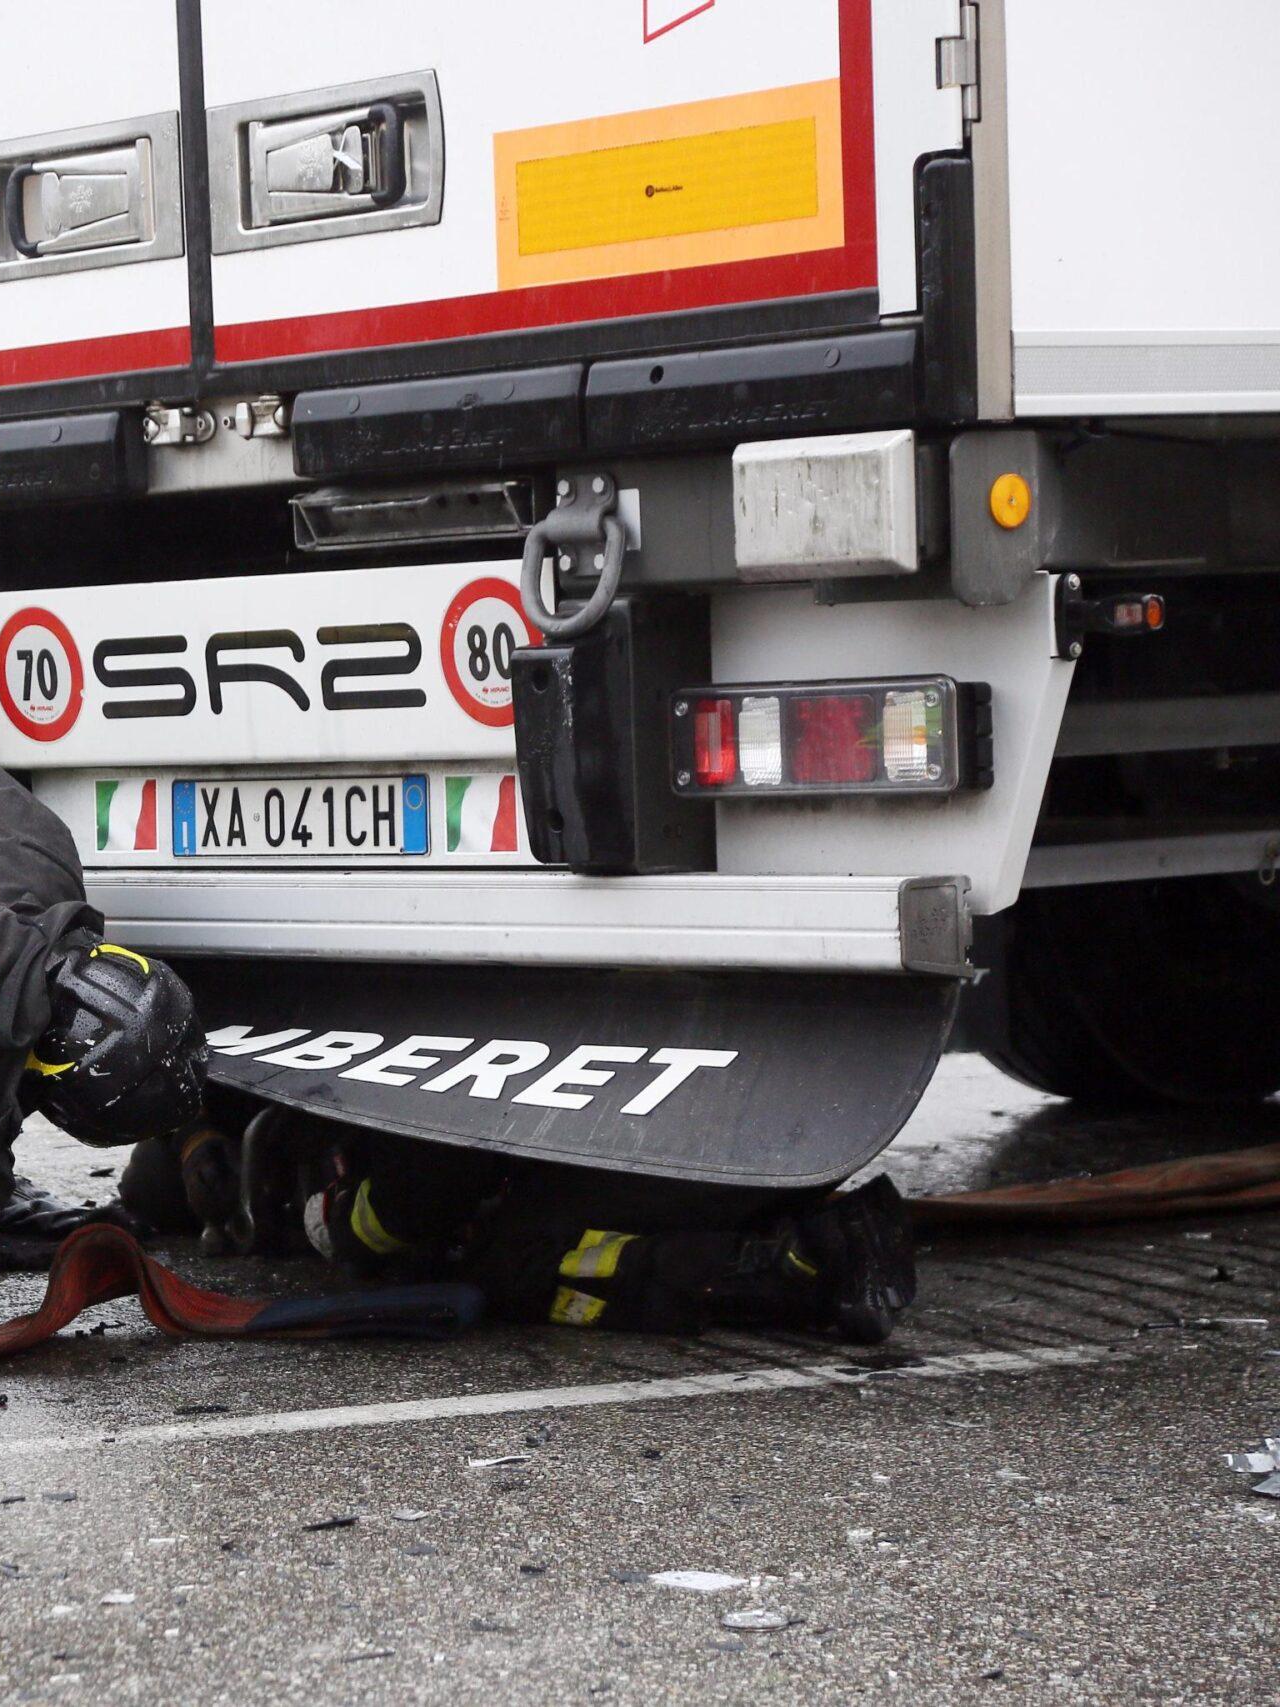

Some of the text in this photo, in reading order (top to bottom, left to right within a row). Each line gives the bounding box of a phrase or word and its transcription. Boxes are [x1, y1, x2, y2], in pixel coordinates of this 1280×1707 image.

[16, 648, 58, 701] 70
[93, 622, 427, 719] SR2
[466, 621, 516, 681] 80
[201, 784, 396, 848] XA 041CH
